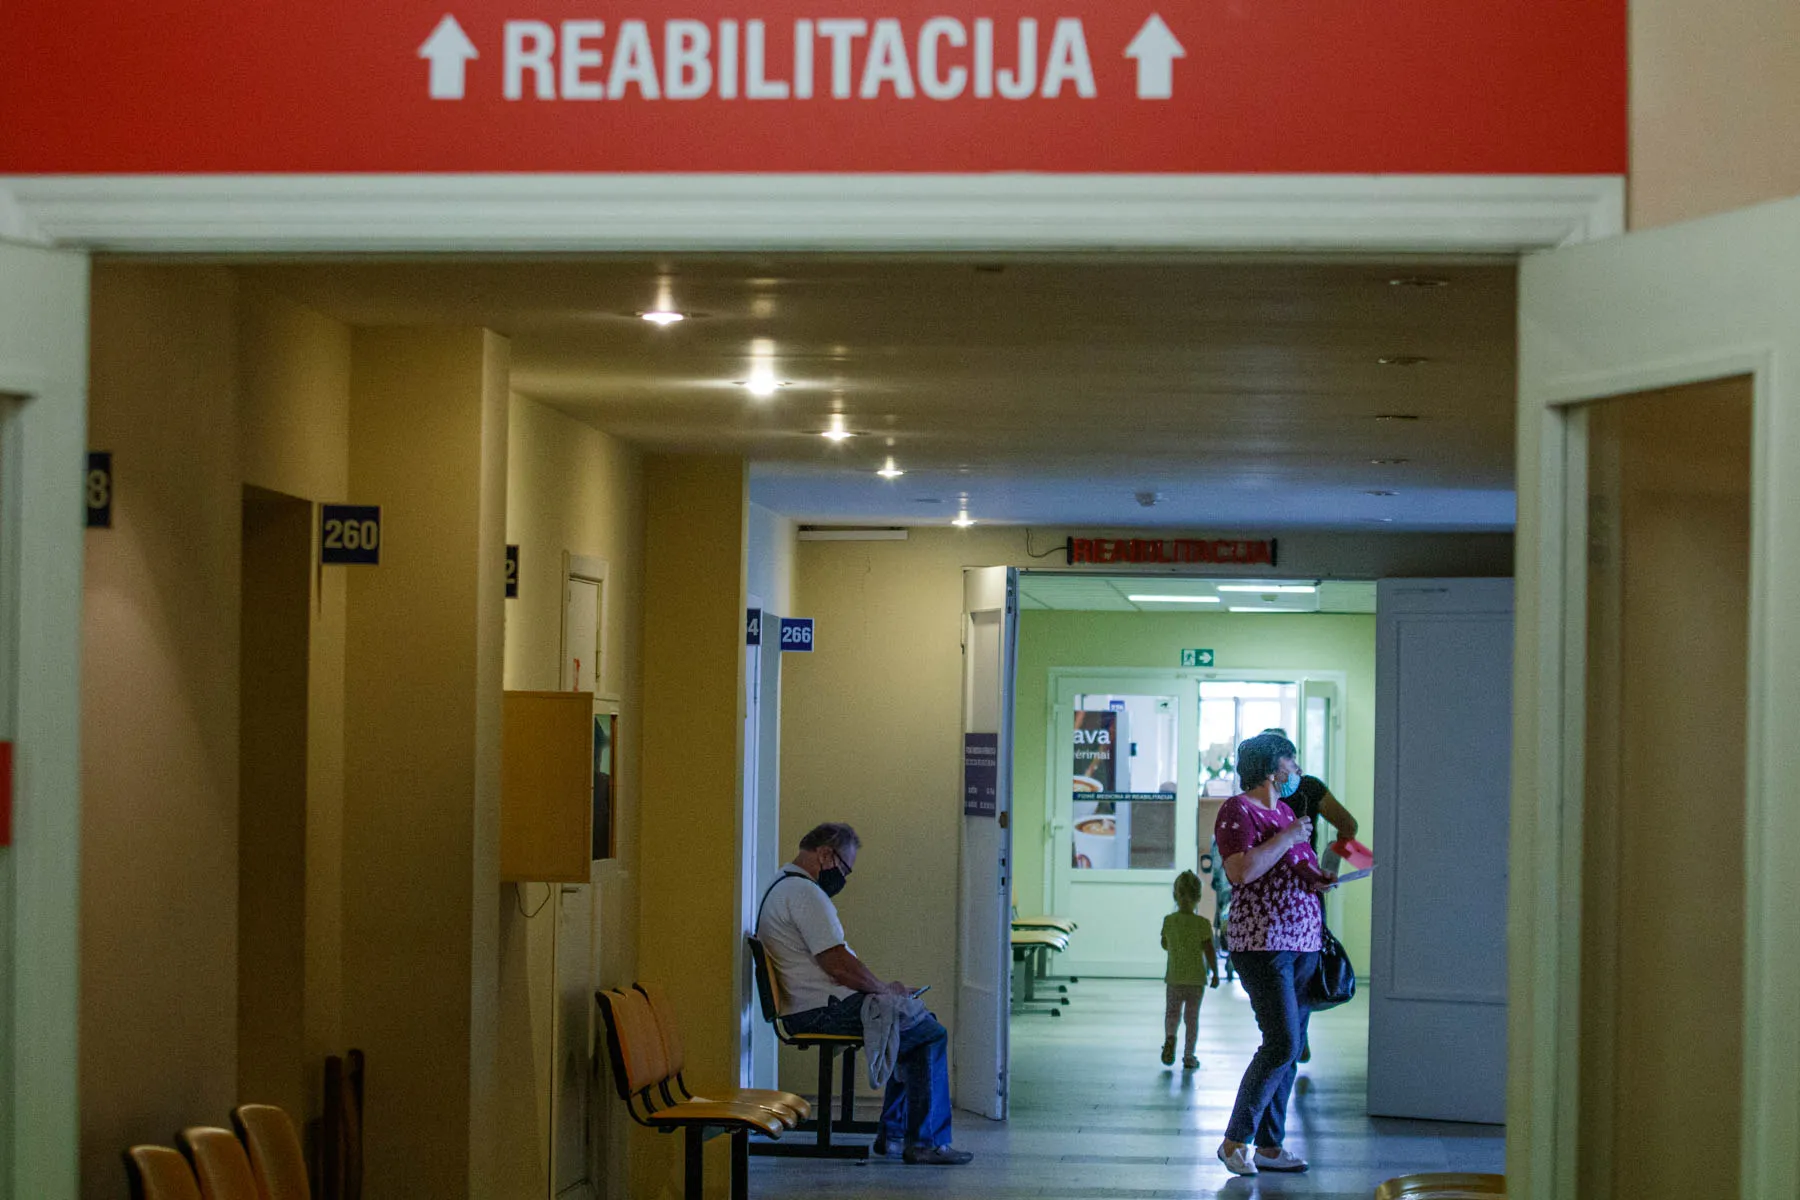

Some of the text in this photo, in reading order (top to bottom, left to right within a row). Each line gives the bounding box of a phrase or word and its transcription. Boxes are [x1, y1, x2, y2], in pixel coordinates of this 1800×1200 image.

[503, 17, 1097, 101] REABILITACIJA
[325, 519, 378, 550] 260
[1073, 538, 1272, 564] REABILITACIJA
[782, 627, 811, 643] 266
